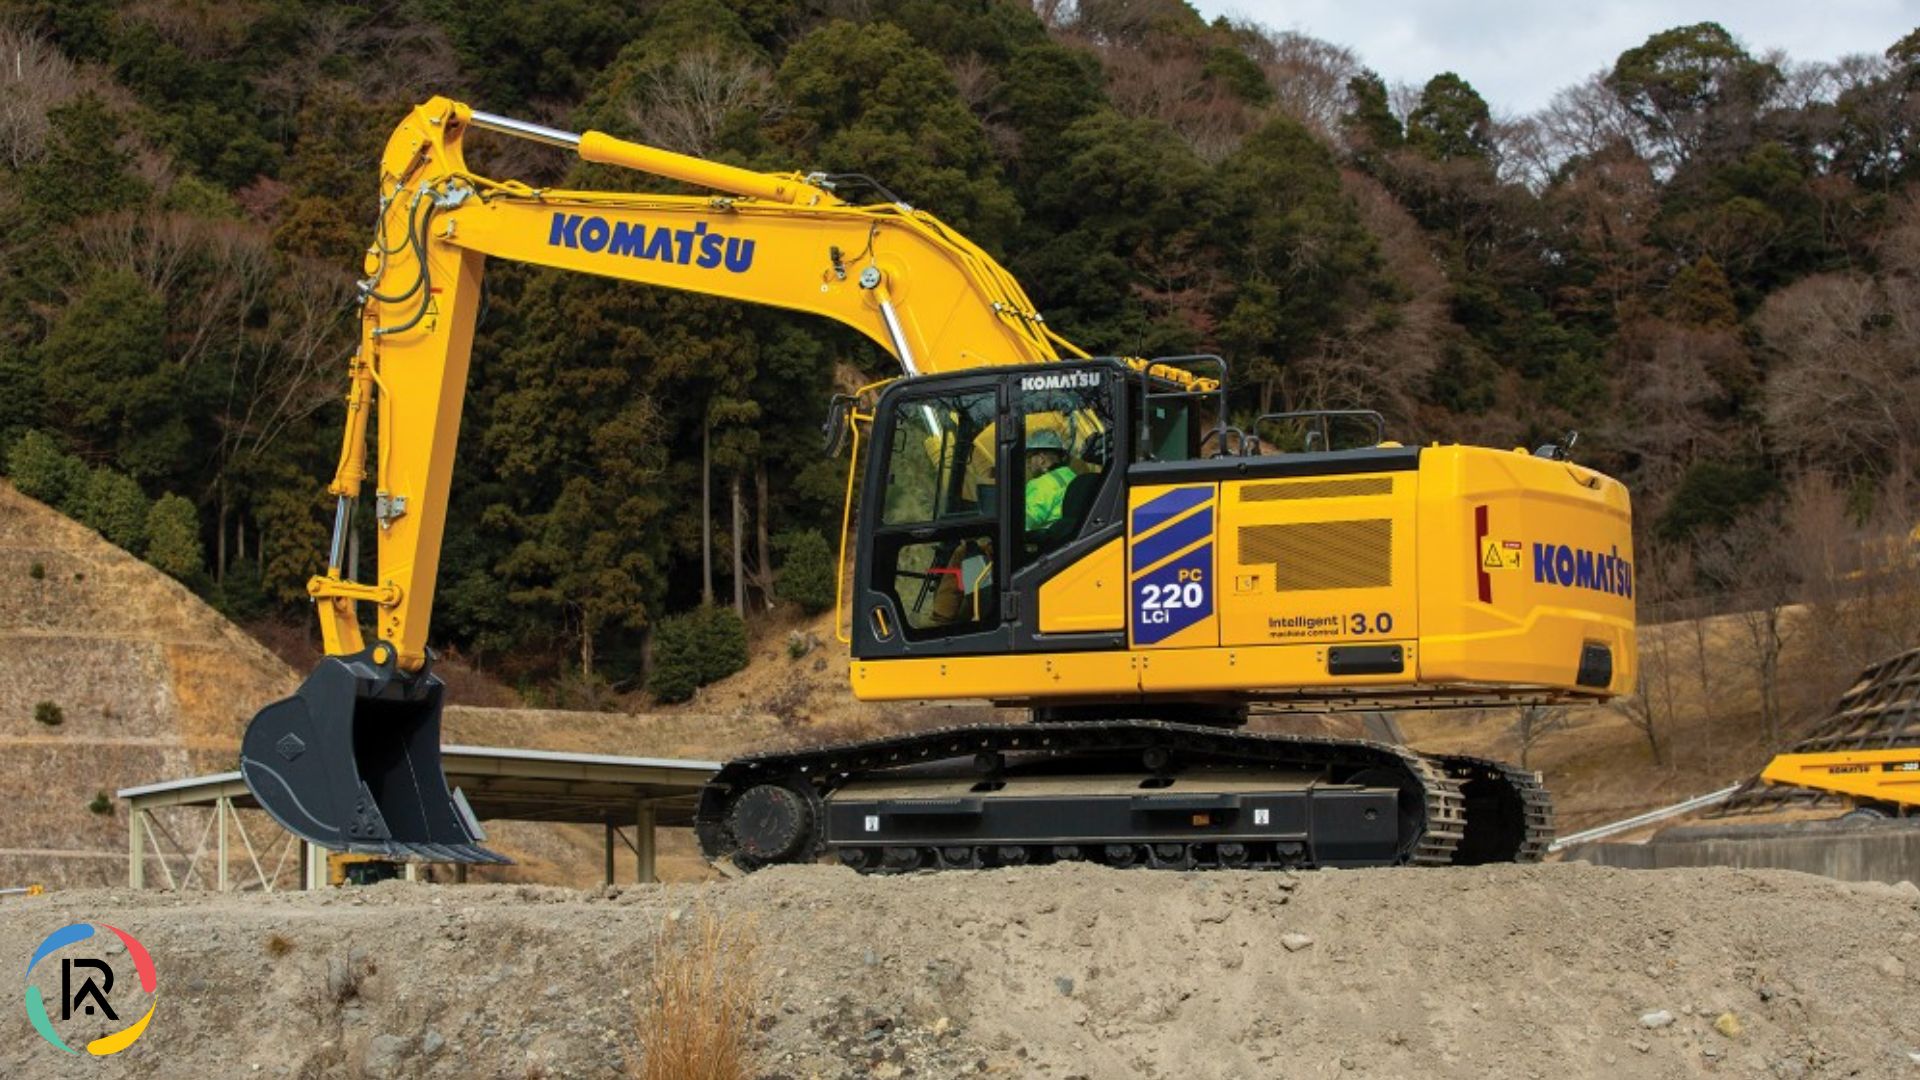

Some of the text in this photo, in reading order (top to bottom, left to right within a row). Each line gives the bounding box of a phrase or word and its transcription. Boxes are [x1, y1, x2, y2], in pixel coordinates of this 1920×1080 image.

[548, 212, 755, 273] KOMATSU
[1021, 369, 1100, 391] KOMATSU
[1178, 568, 1202, 582] PC
[1533, 542, 1632, 600] KOMATSU
[1141, 582, 1203, 610] 220
[1268, 612, 1393, 635] Intelligent 3.0
